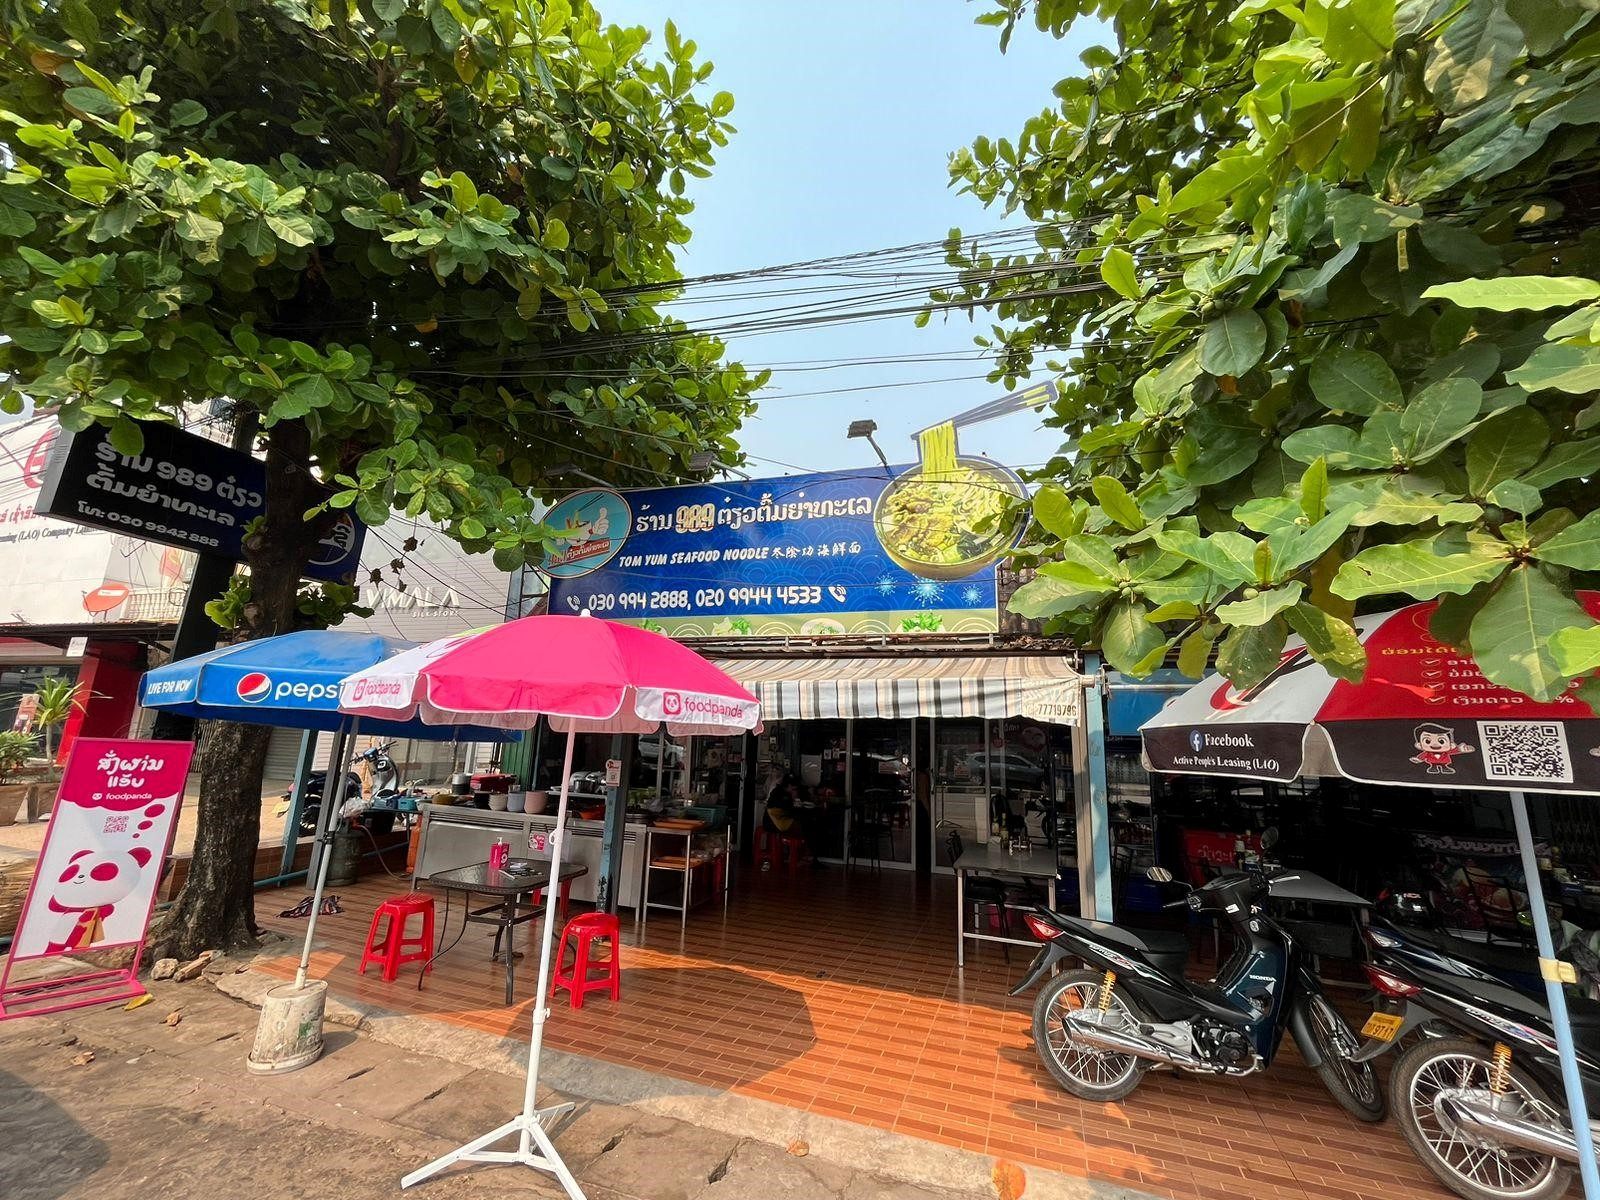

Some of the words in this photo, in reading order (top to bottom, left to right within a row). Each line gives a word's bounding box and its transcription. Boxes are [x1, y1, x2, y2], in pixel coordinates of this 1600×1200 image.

[156, 461, 213, 491] 989
[636, 504, 673, 532] ຮ້ານ
[675, 503, 716, 534] 989
[107, 512, 144, 527] 030
[145, 522, 188, 539] 9942
[188, 532, 220, 547] 888
[619, 555, 642, 567] TOM
[645, 553, 668, 566] YUM
[670, 549, 721, 564] SEAFOOD
[723, 546, 769, 561] NOODLE
[588, 593, 614, 611] 030
[618, 591, 646, 610] 994
[695, 588, 725, 607] 020
[729, 587, 772, 605] 9944
[776, 585, 822, 605] 4533
[274, 681, 345, 702] pepsi
[684, 697, 743, 719] foodpanda
[1204, 733, 1255, 748] Facebook
[1173, 756, 1193, 765] Active
[1217, 757, 1251, 770] Leasing
[107, 773, 145, 788] ແອັບ
[106, 792, 152, 801] foodpanda
